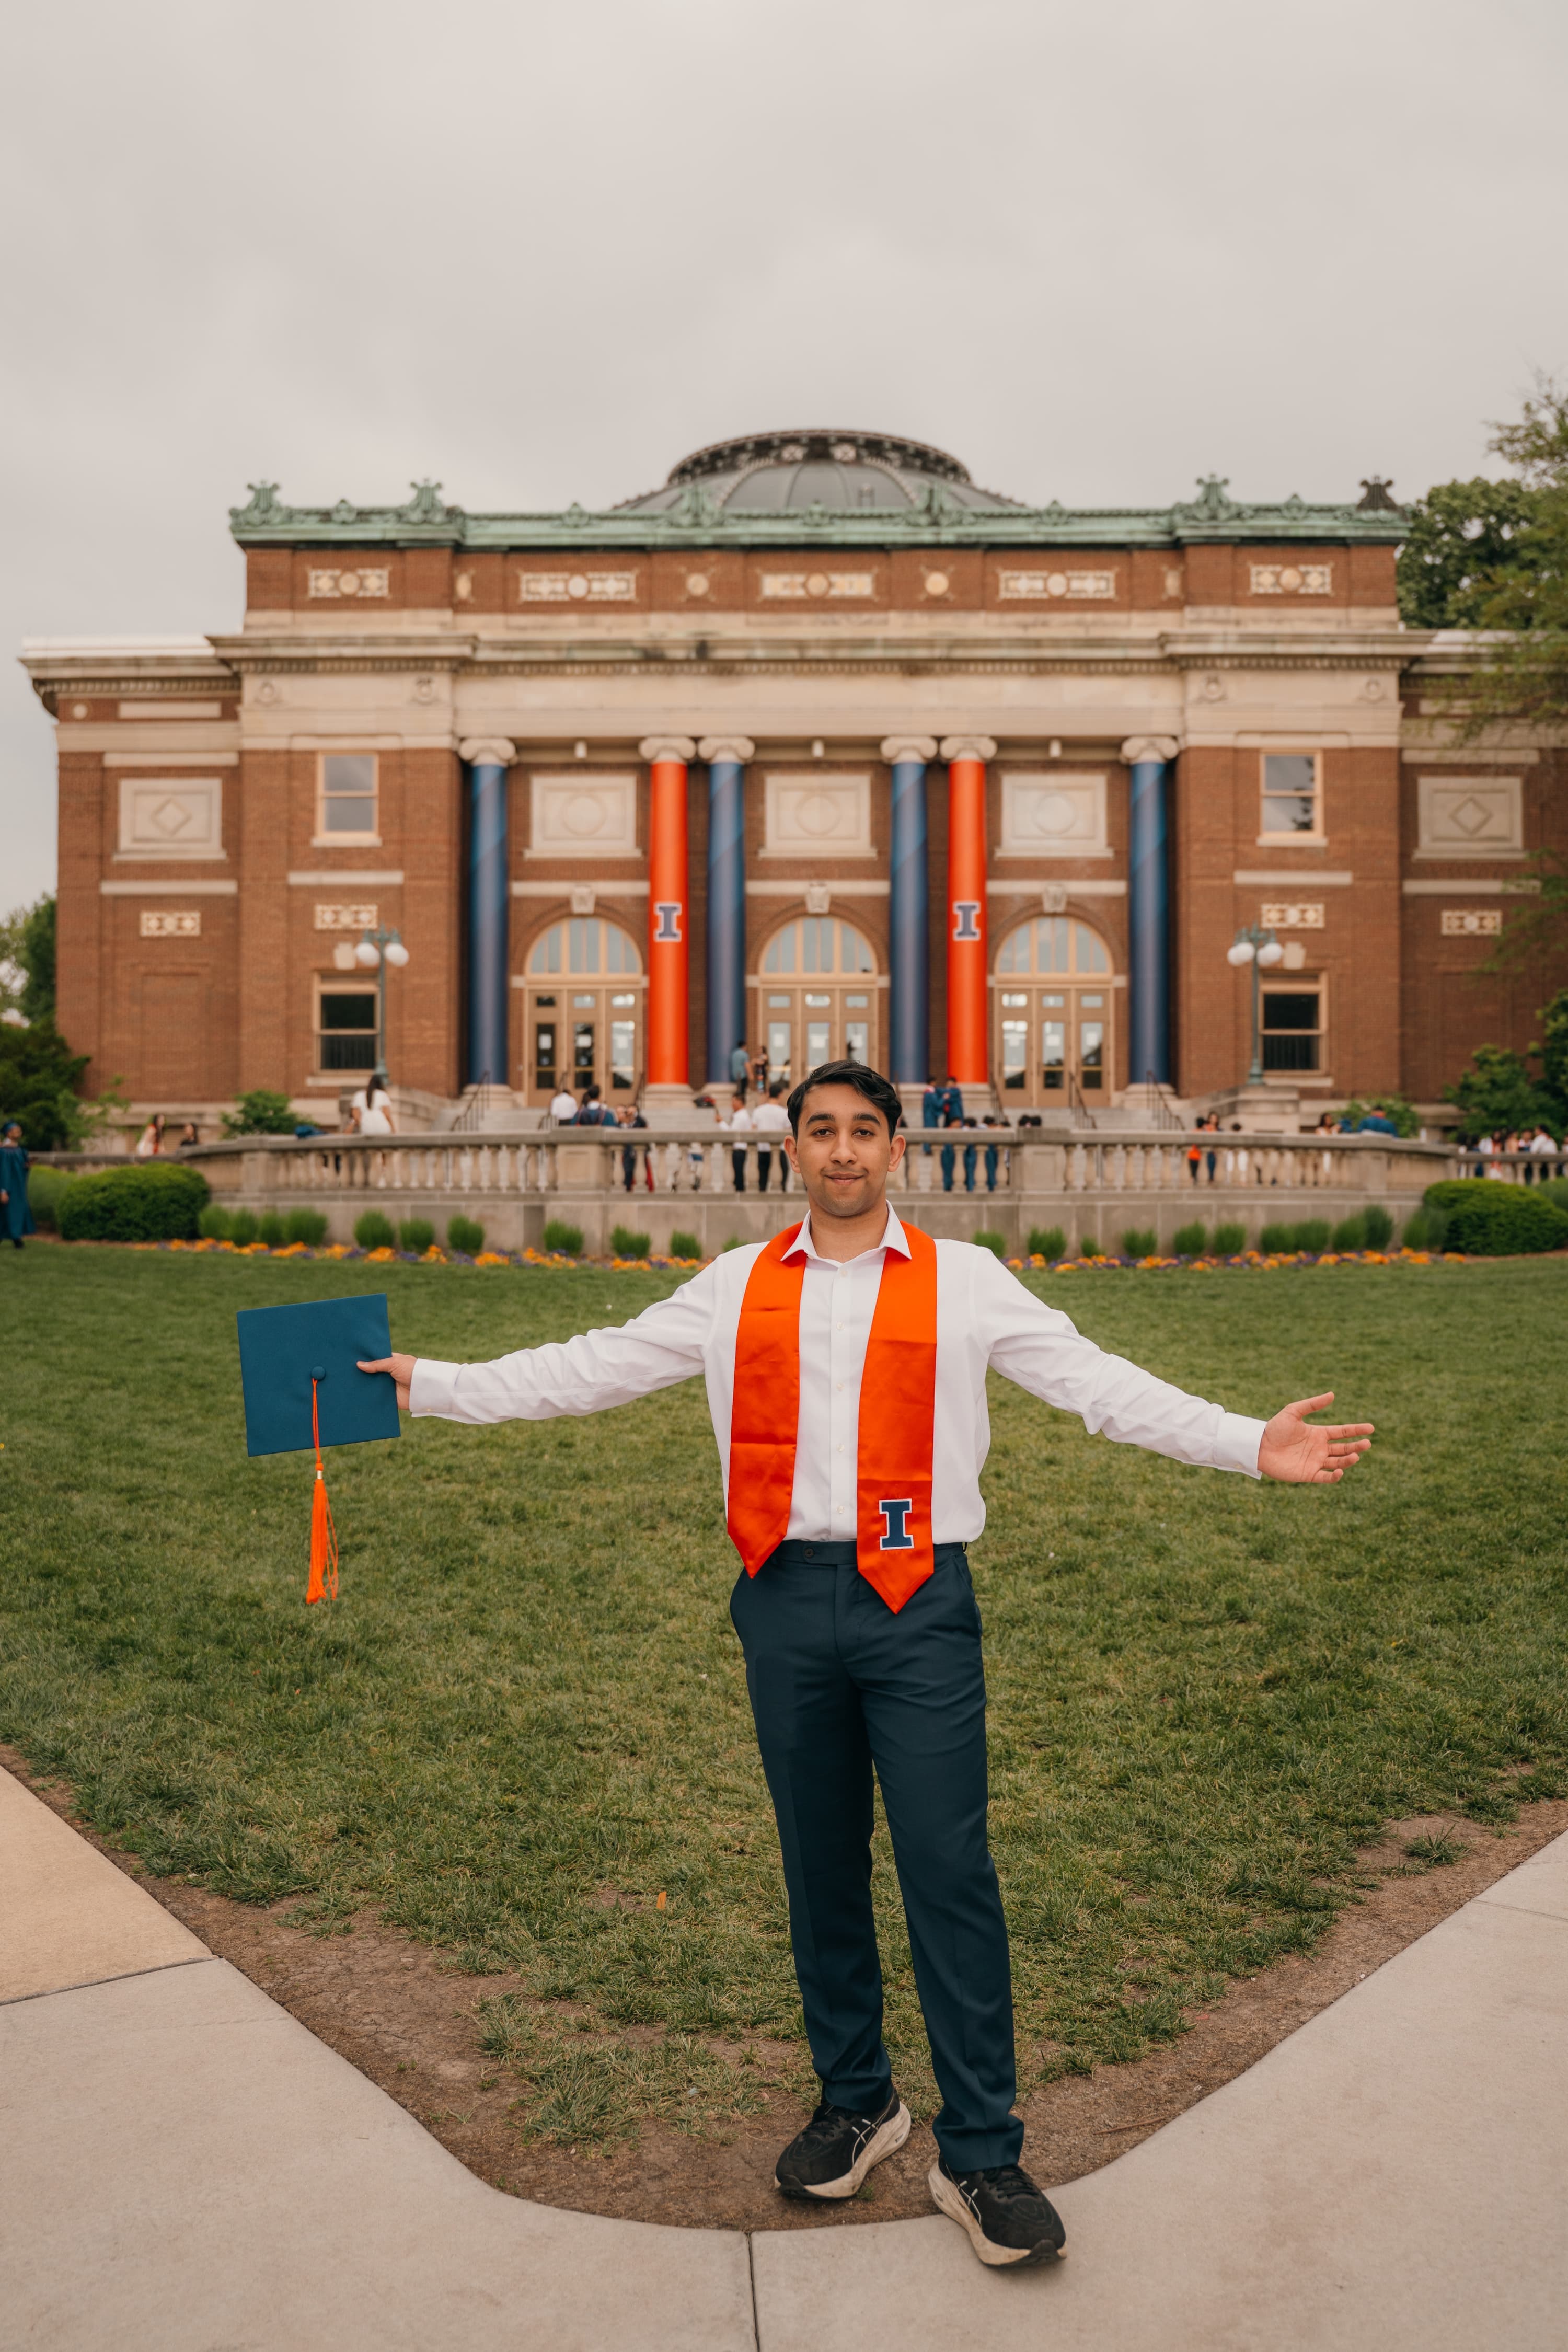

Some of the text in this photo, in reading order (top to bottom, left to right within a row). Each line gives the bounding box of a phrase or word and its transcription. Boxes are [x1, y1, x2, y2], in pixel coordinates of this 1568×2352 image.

[655, 903, 682, 941] I
[953, 902, 981, 941] I
[879, 1498, 914, 1550] I
